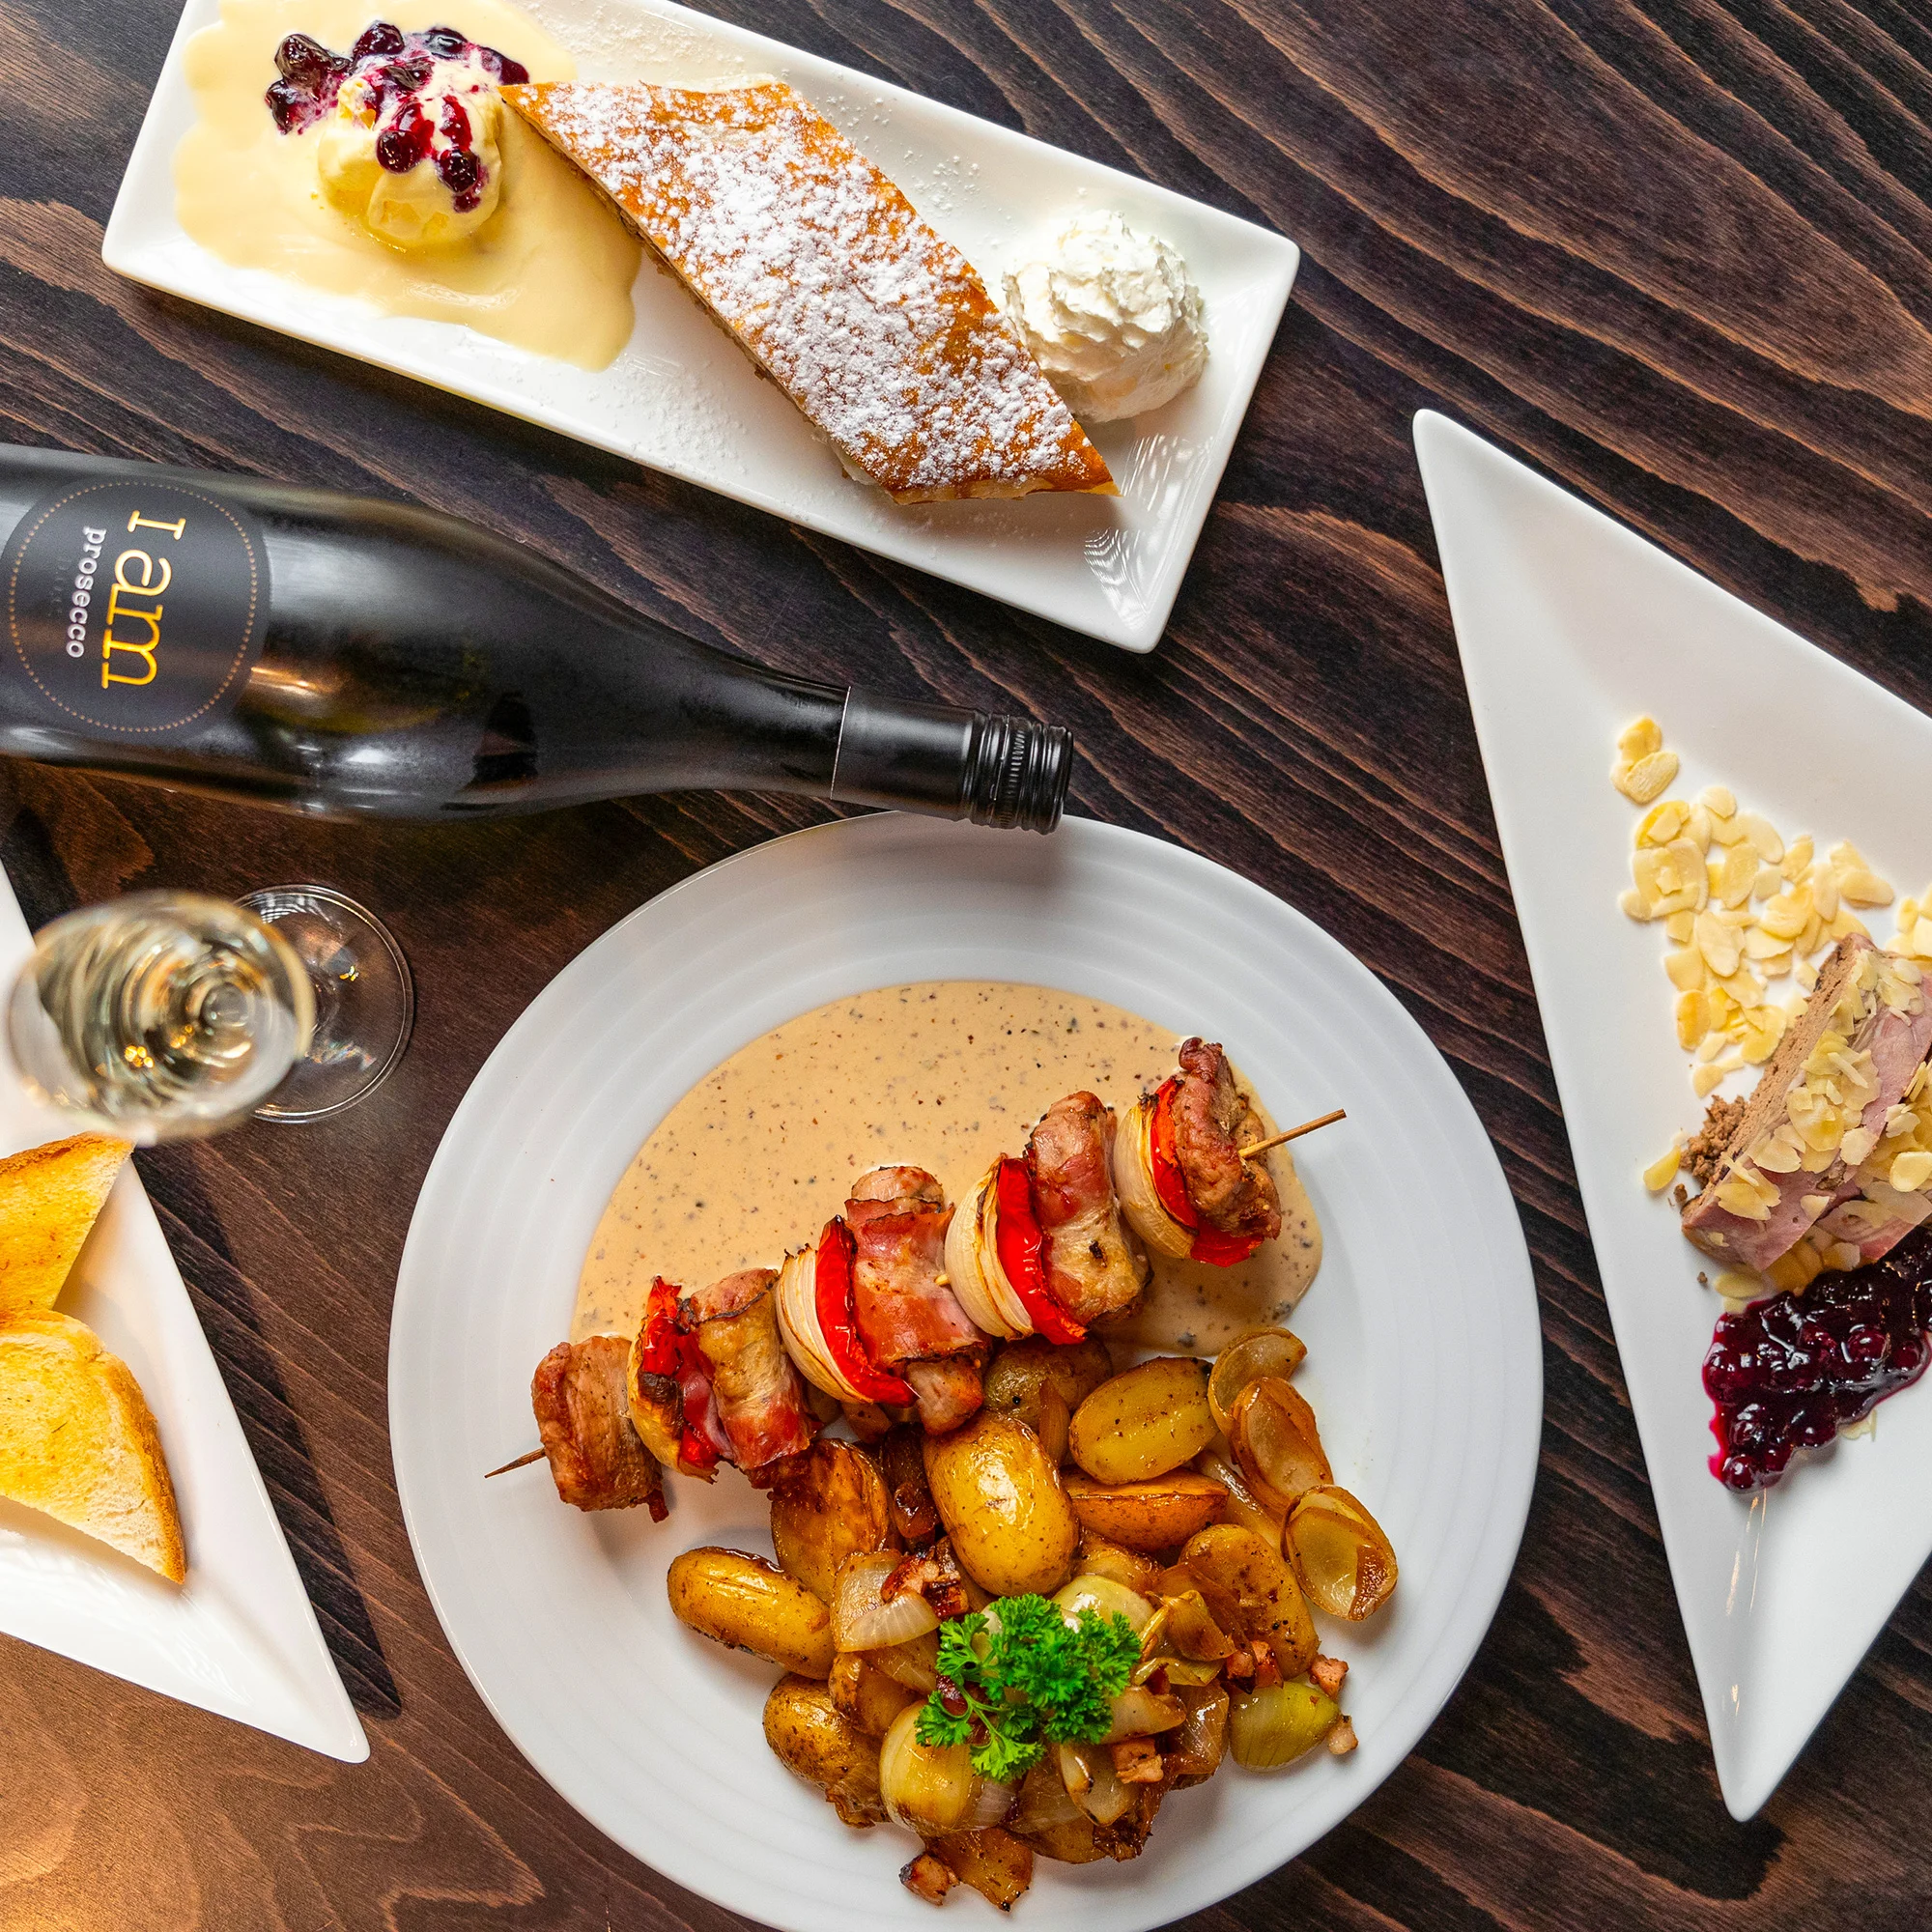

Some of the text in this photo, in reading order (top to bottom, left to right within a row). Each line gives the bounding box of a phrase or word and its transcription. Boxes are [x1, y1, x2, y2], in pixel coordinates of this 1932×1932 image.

[65, 525, 108, 659] prosecco
[101, 509, 186, 690] I am
